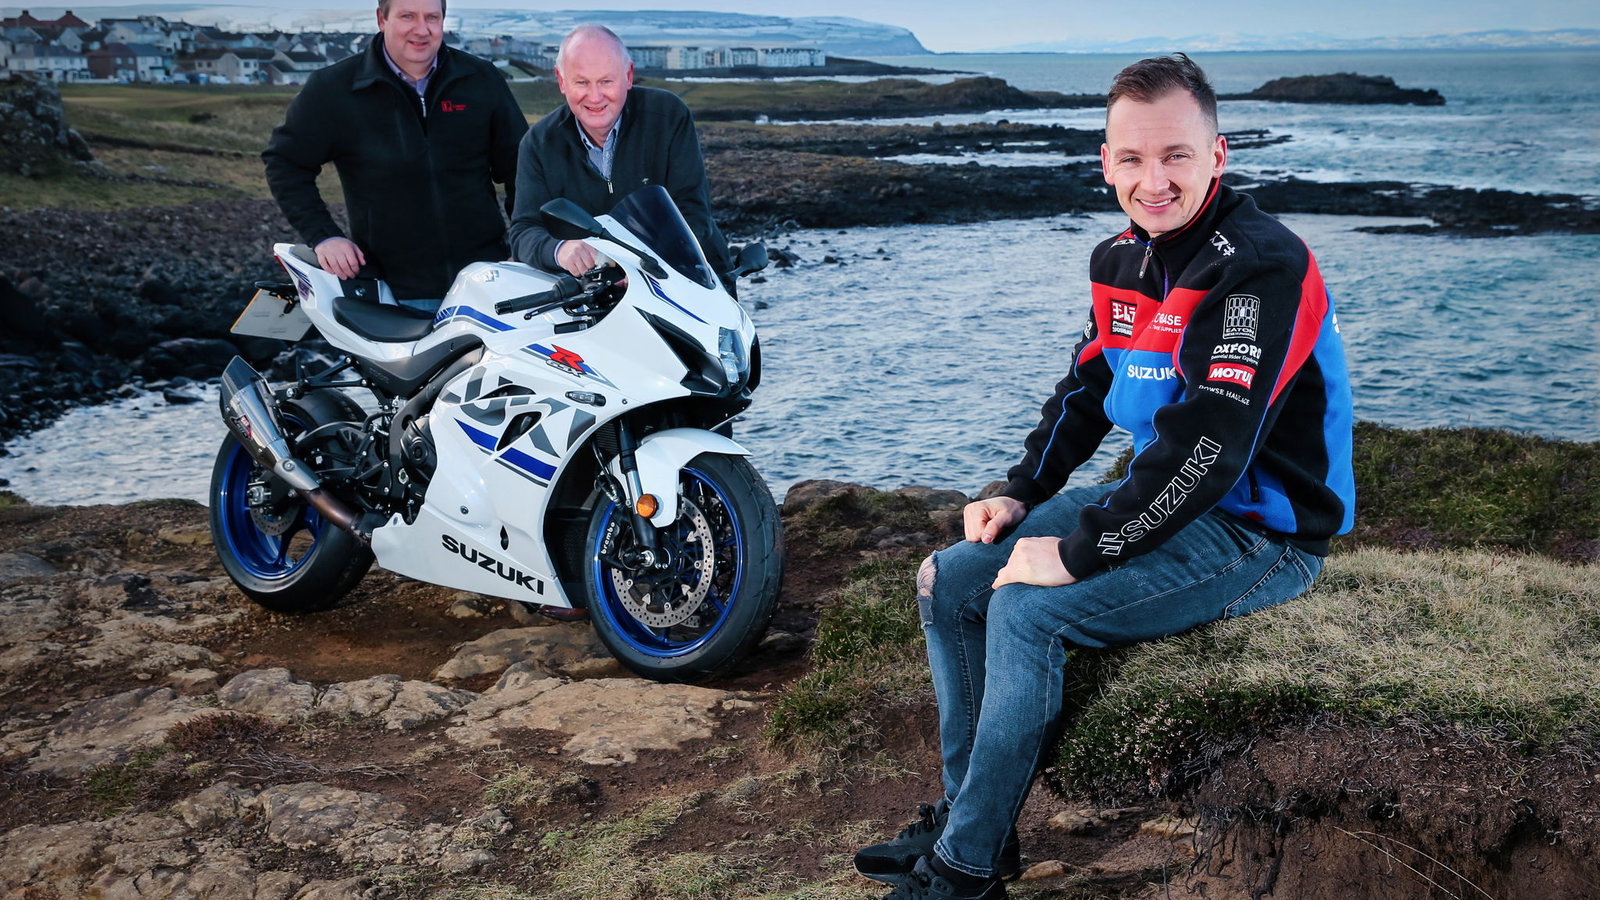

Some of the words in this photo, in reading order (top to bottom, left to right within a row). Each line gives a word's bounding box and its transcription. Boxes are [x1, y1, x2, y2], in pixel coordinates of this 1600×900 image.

[1127, 364, 1177, 381] SUZUK
[1121, 436, 1222, 542] SUZUKI
[600, 521, 616, 555] brembo
[442, 534, 544, 596] SUZUKI
